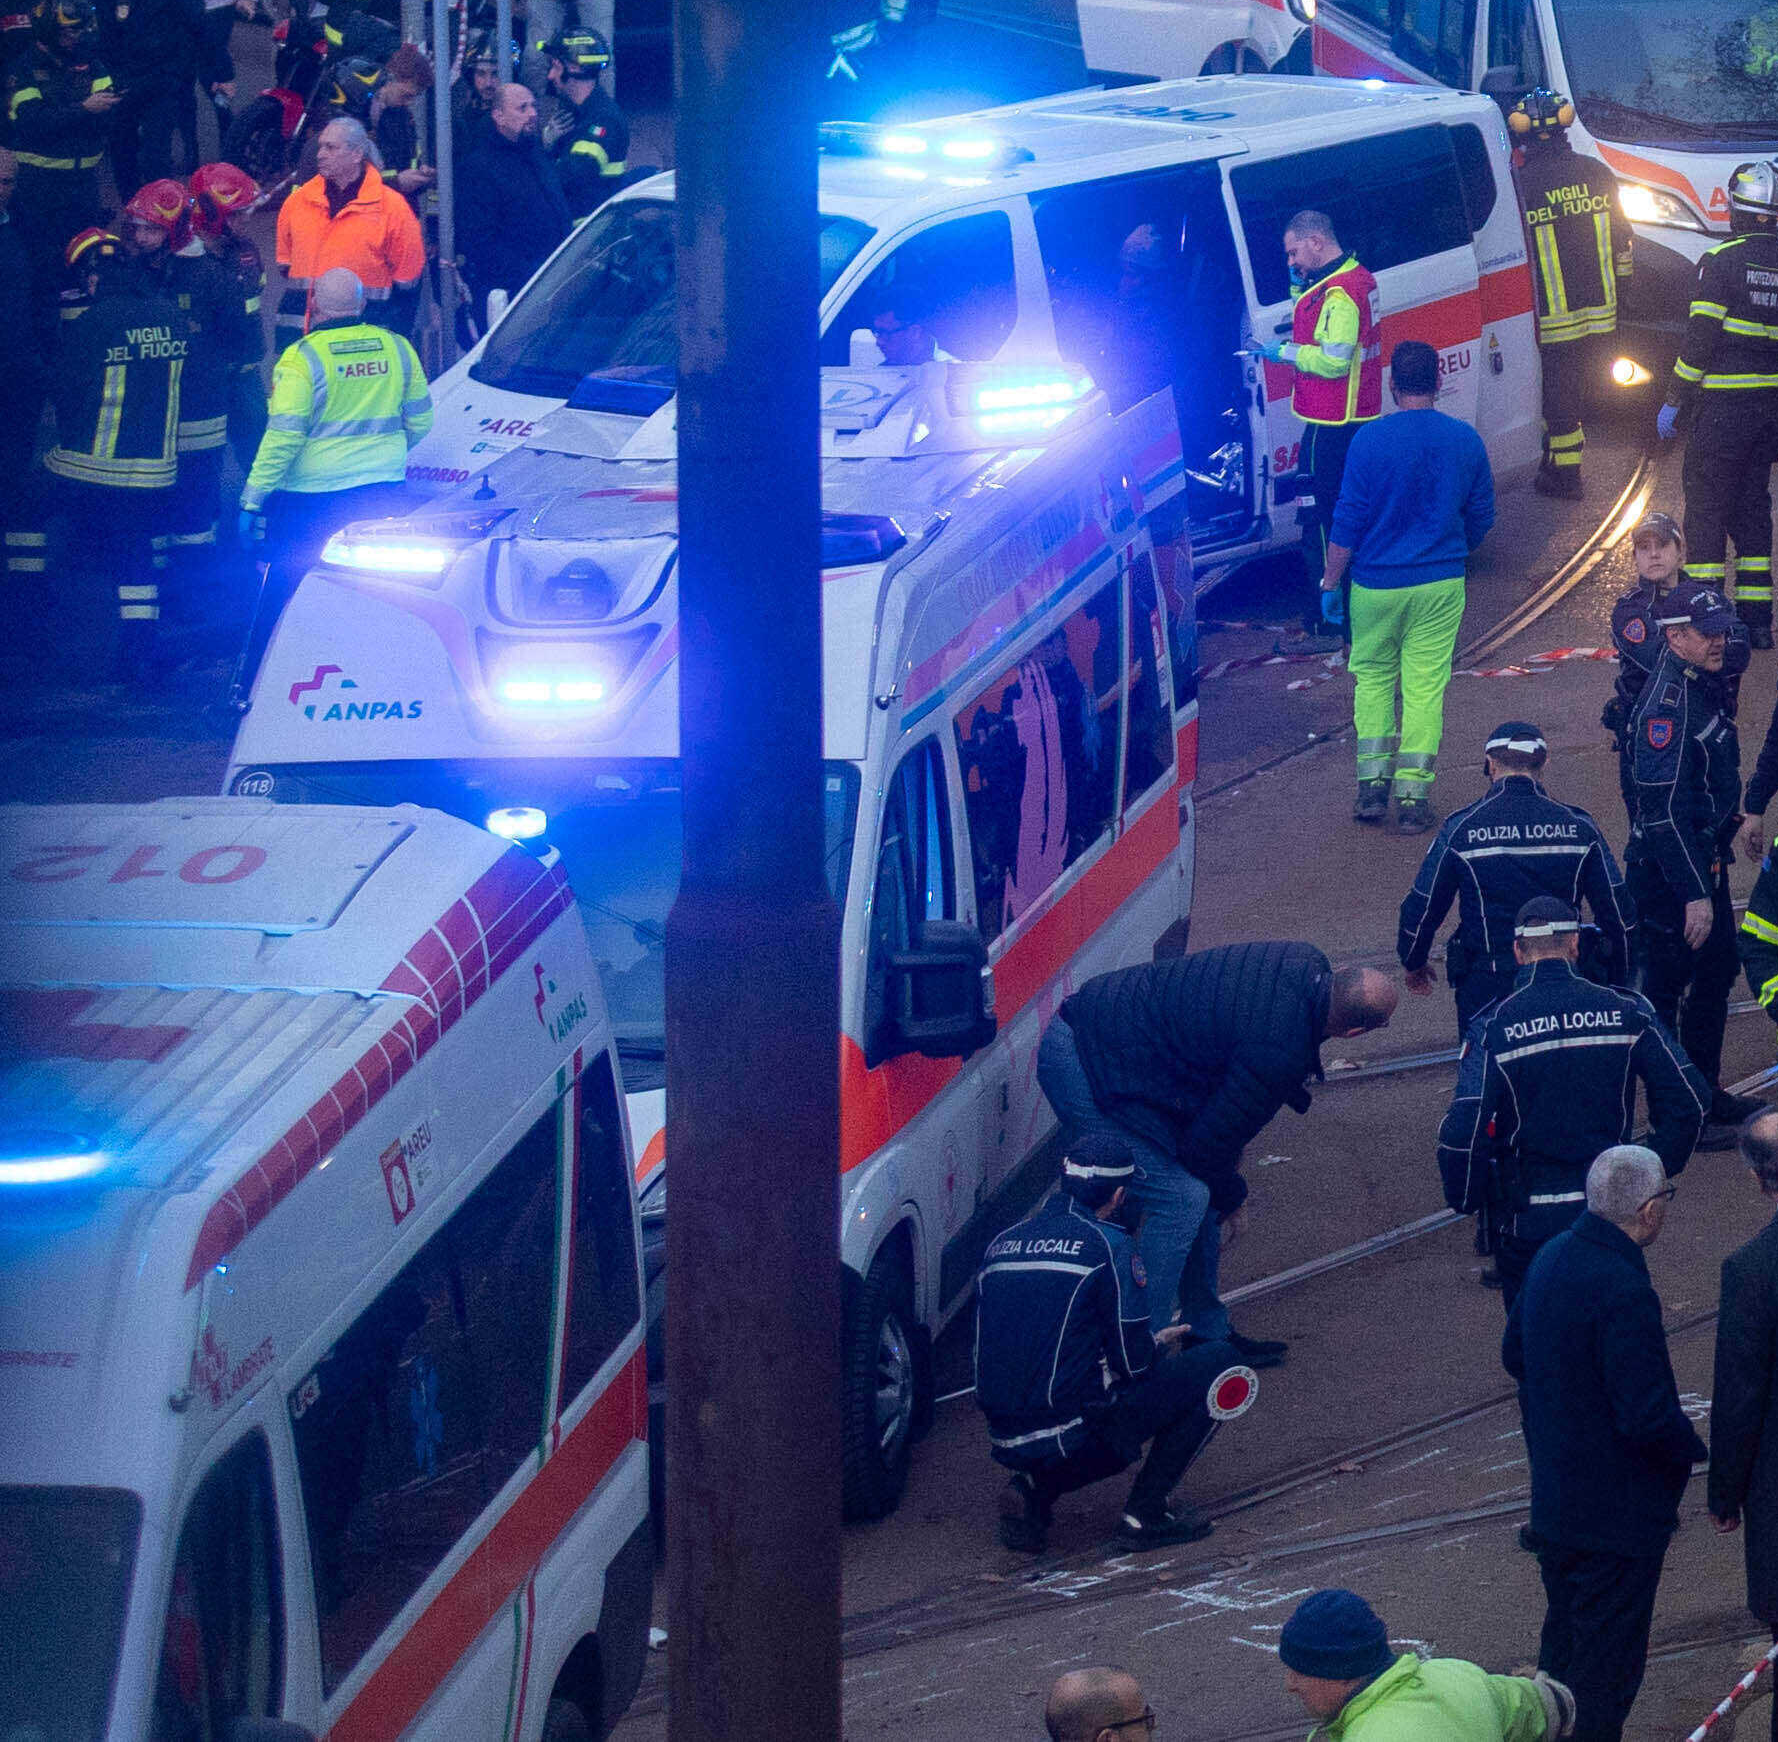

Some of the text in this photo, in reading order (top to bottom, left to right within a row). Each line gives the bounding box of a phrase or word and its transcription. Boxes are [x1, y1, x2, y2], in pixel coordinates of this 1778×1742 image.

[1545, 183, 1589, 204] VIGILI
[1526, 207, 1558, 225] DEL
[126, 326, 171, 343] VIGILI
[345, 361, 389, 378] AREU
[481, 418, 537, 437] ARE
[323, 699, 424, 723] ANPAS
[240, 779, 271, 794] 118
[1468, 824, 1578, 843] POLIZIA LOCALE
[1504, 1010, 1623, 1042] POLIZIA LOCALE
[1025, 1238, 1084, 1256] LOCALE
